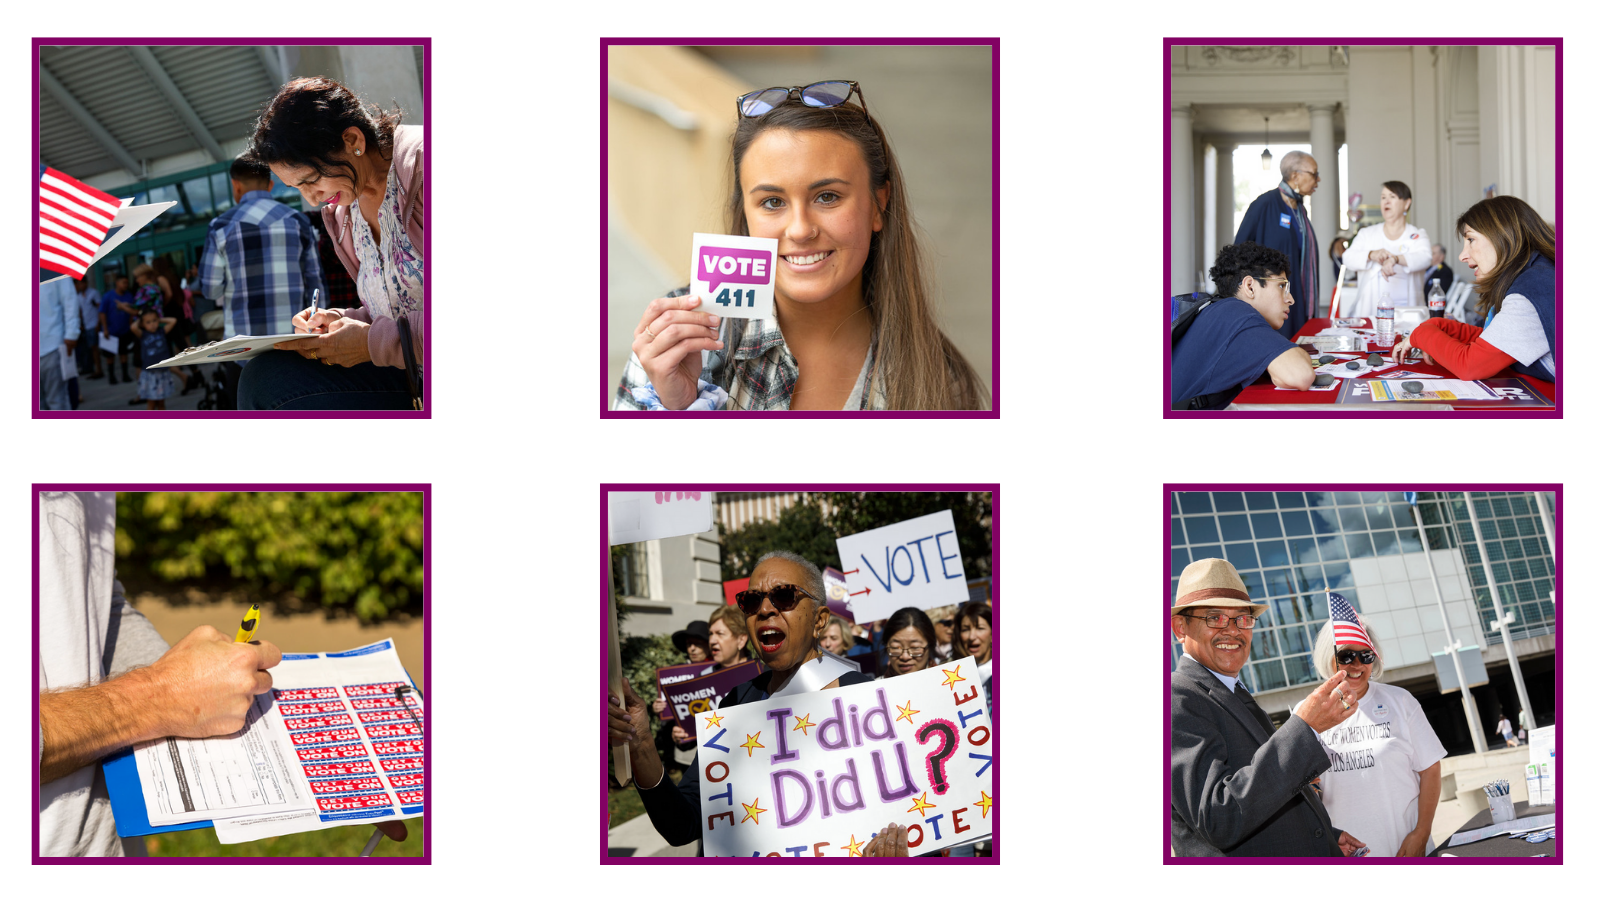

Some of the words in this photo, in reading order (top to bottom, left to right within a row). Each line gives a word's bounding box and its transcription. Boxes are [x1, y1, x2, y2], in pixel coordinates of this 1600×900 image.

[702, 254, 767, 277] VOTE
[715, 288, 756, 307] 411
[861, 530, 962, 593] VOTE
[659, 674, 694, 685] WOMEN
[316, 691, 338, 699] ON
[670, 687, 717, 704] WOMEN
[282, 707, 319, 715] VOTE
[288, 721, 326, 729] VOTE
[329, 717, 352, 726] ON
[766, 707, 800, 765] I
[816, 687, 898, 751] did
[322, 728, 356, 736] YOUR
[369, 729, 407, 737] VOTE
[953, 685, 993, 778] VOTE
[1340, 726, 1365, 744] WOMEN
[1366, 721, 1391, 739] VOTERS
[294, 735, 332, 743] VOTE
[336, 732, 359, 741] ON
[301, 751, 340, 759] VOTE
[343, 749, 366, 757] ON
[376, 745, 416, 753] VOTE
[384, 762, 423, 770] VOTE
[1331, 752, 1345, 773] LOS
[1346, 748, 1376, 771] ANGELES
[307, 768, 347, 776] VOTE
[392, 778, 423, 786] VOT
[702, 728, 735, 830] VOTE
[315, 784, 355, 792] VOTE
[770, 758, 866, 829] Did
[321, 801, 363, 809] VOTE
[871, 807, 971, 848] OTE
